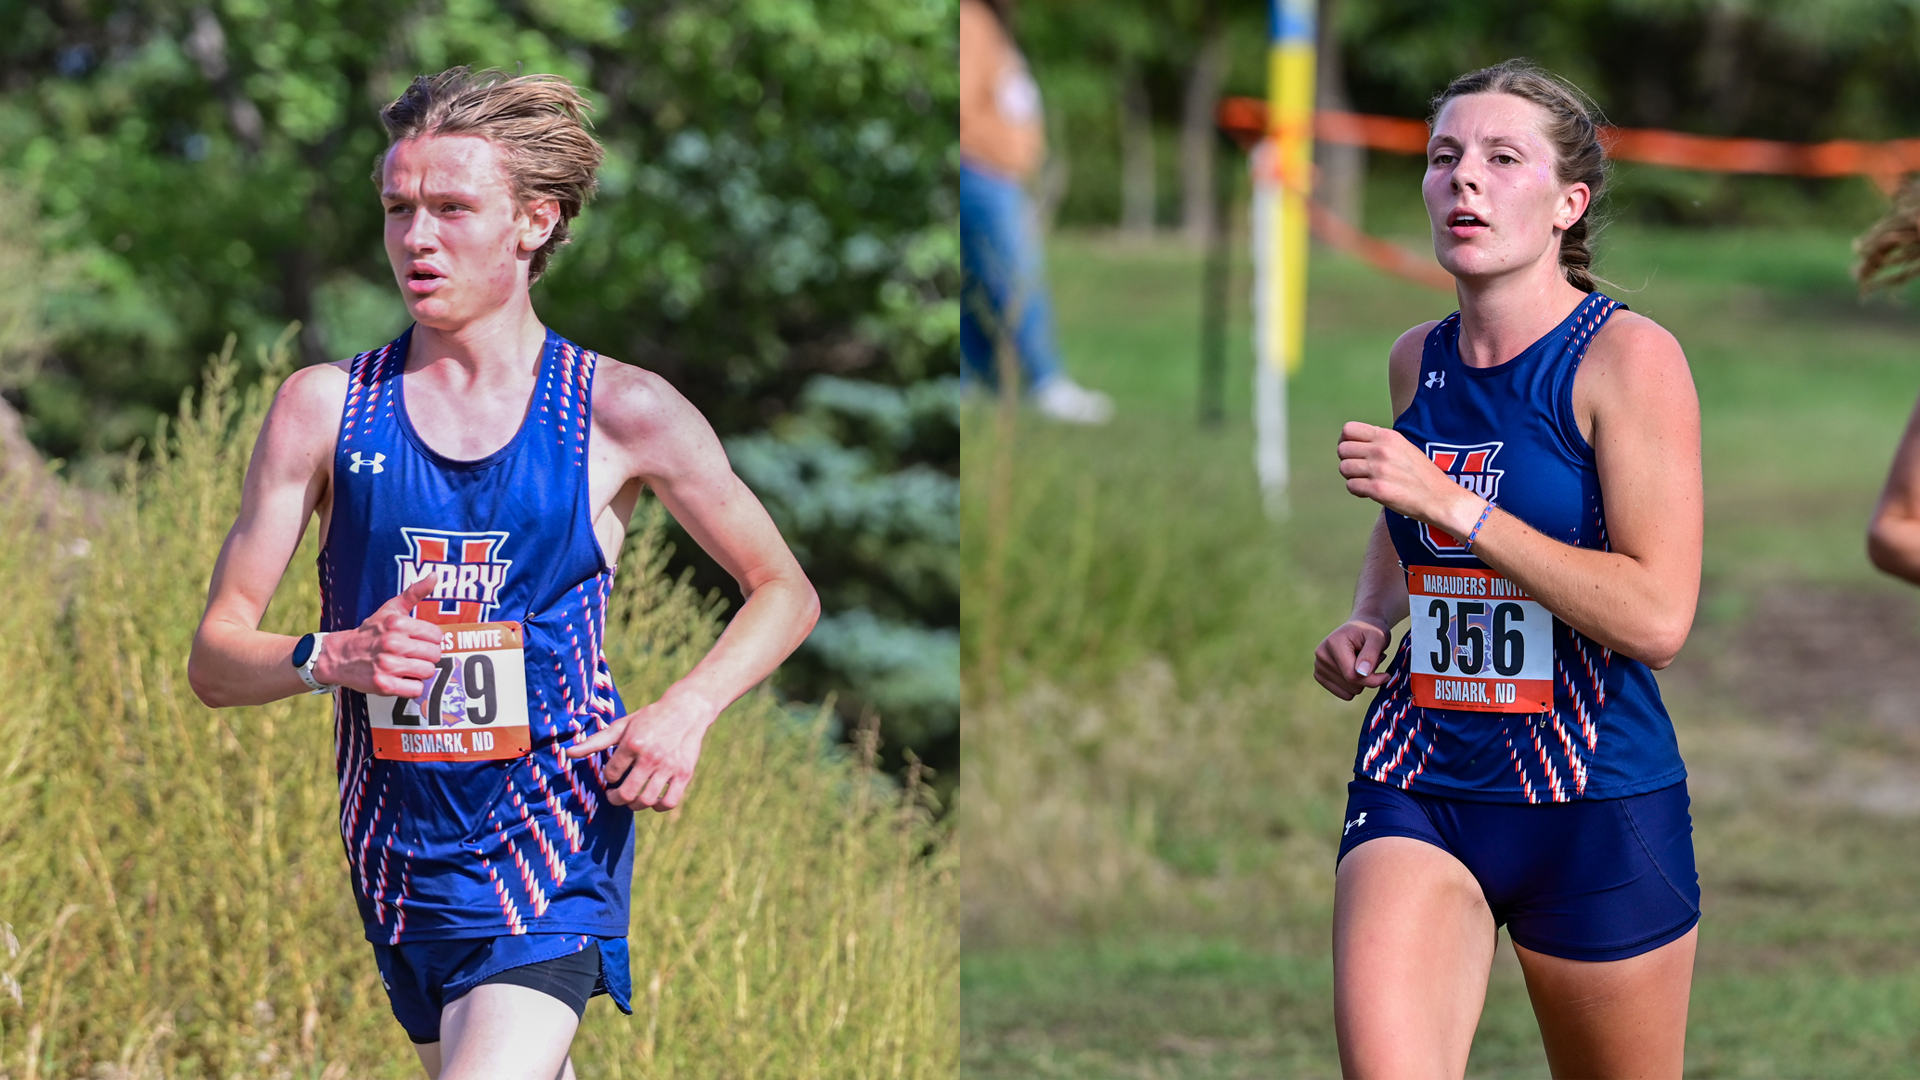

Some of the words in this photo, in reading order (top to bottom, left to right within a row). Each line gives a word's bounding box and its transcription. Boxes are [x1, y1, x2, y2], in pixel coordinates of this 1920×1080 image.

[1423, 574, 1486, 596] MARAUDERS
[1490, 577, 1530, 598] INVI
[457, 629, 502, 650] INVITE
[1428, 598, 1525, 677] 356
[1434, 679, 1491, 705] BISMARK,
[1495, 683, 1517, 704] ND
[401, 733, 468, 755] BISMARK,
[472, 731, 494, 752] ND
